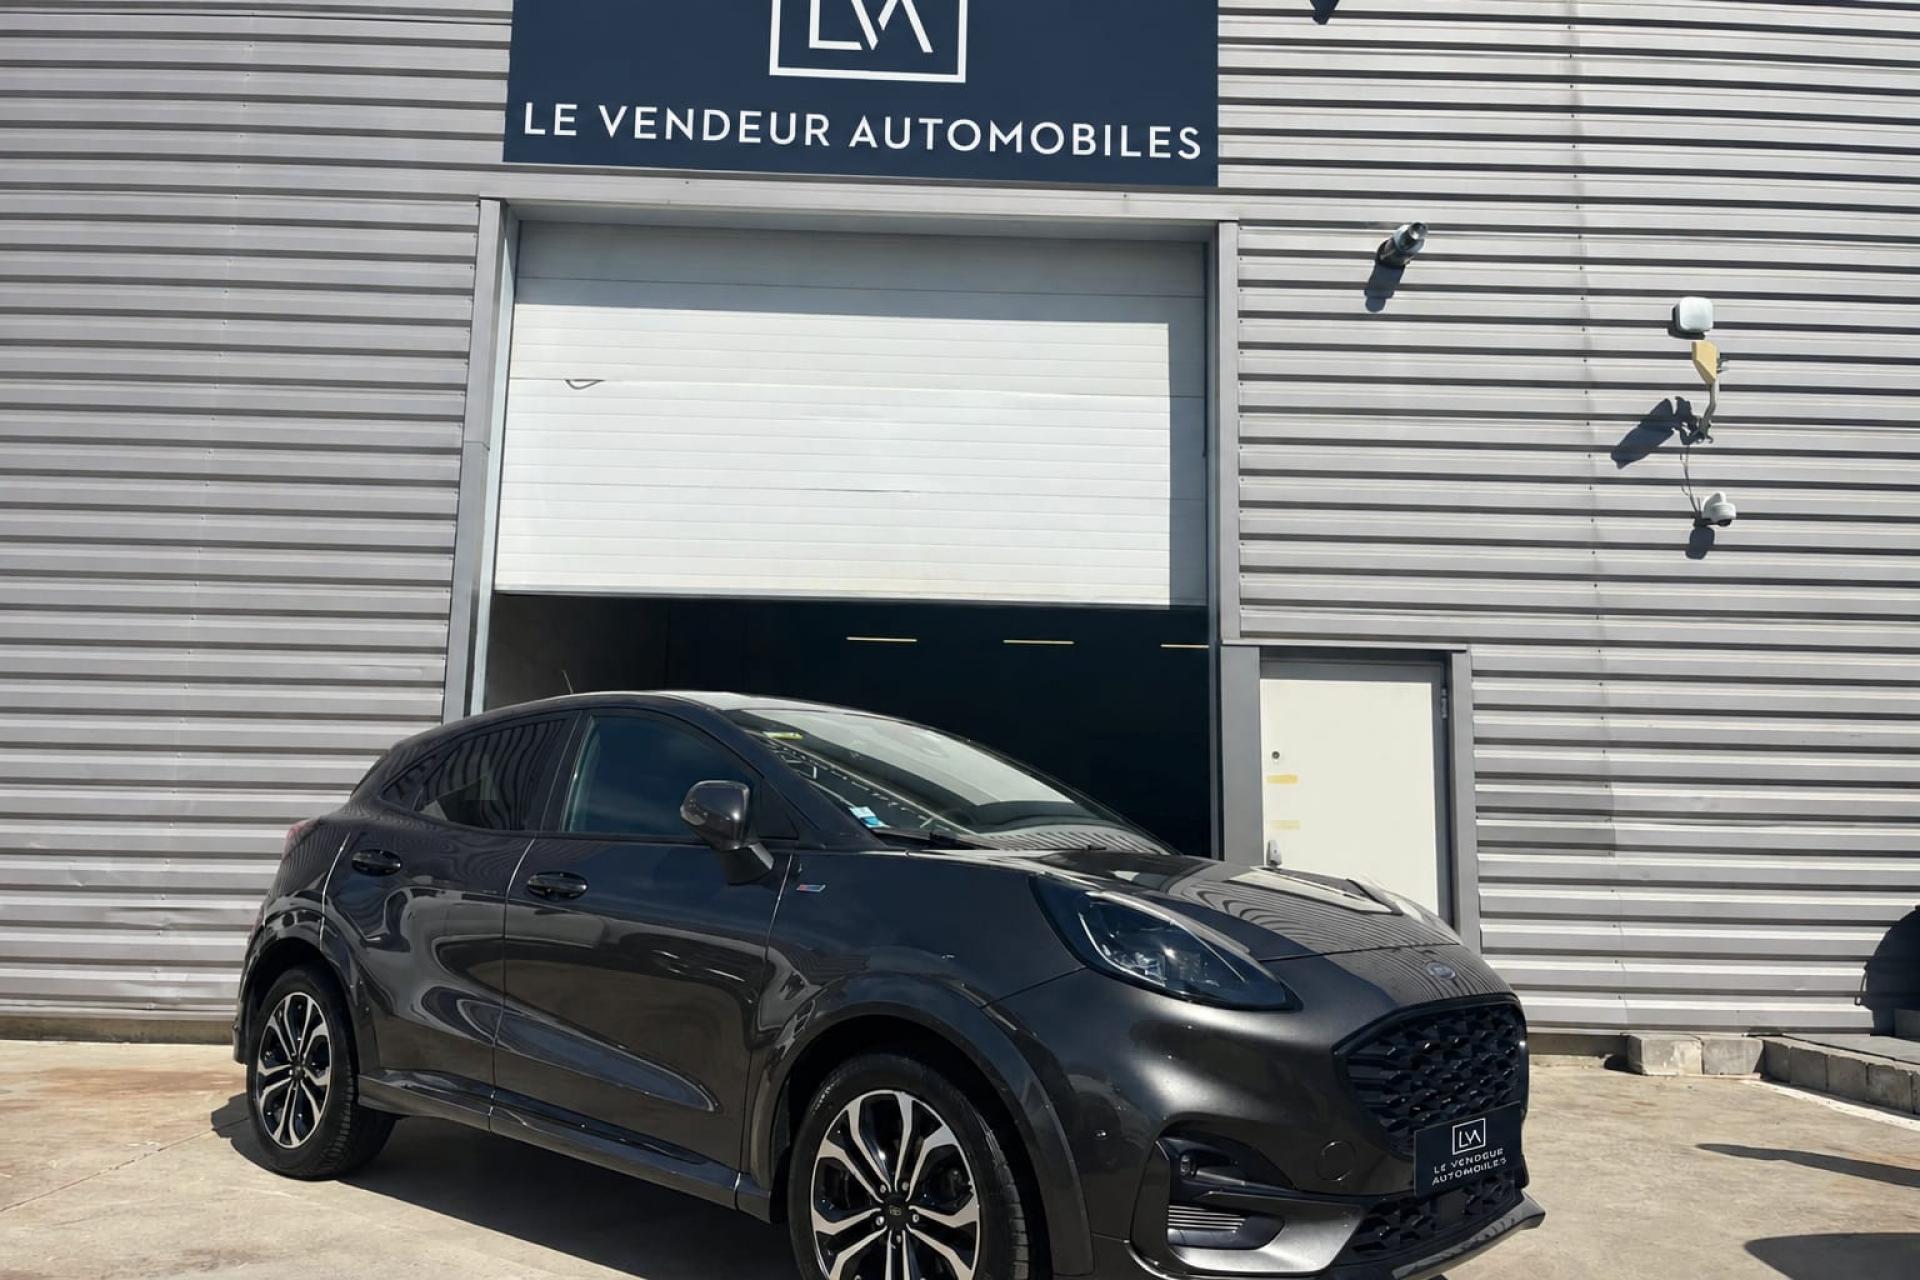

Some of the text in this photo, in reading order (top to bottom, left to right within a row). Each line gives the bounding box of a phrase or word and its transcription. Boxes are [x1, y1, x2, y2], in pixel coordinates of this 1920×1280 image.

[525, 101, 1202, 161] LE VENDEUR AUTOMOBILES
[1434, 1163, 1446, 1174] LE
